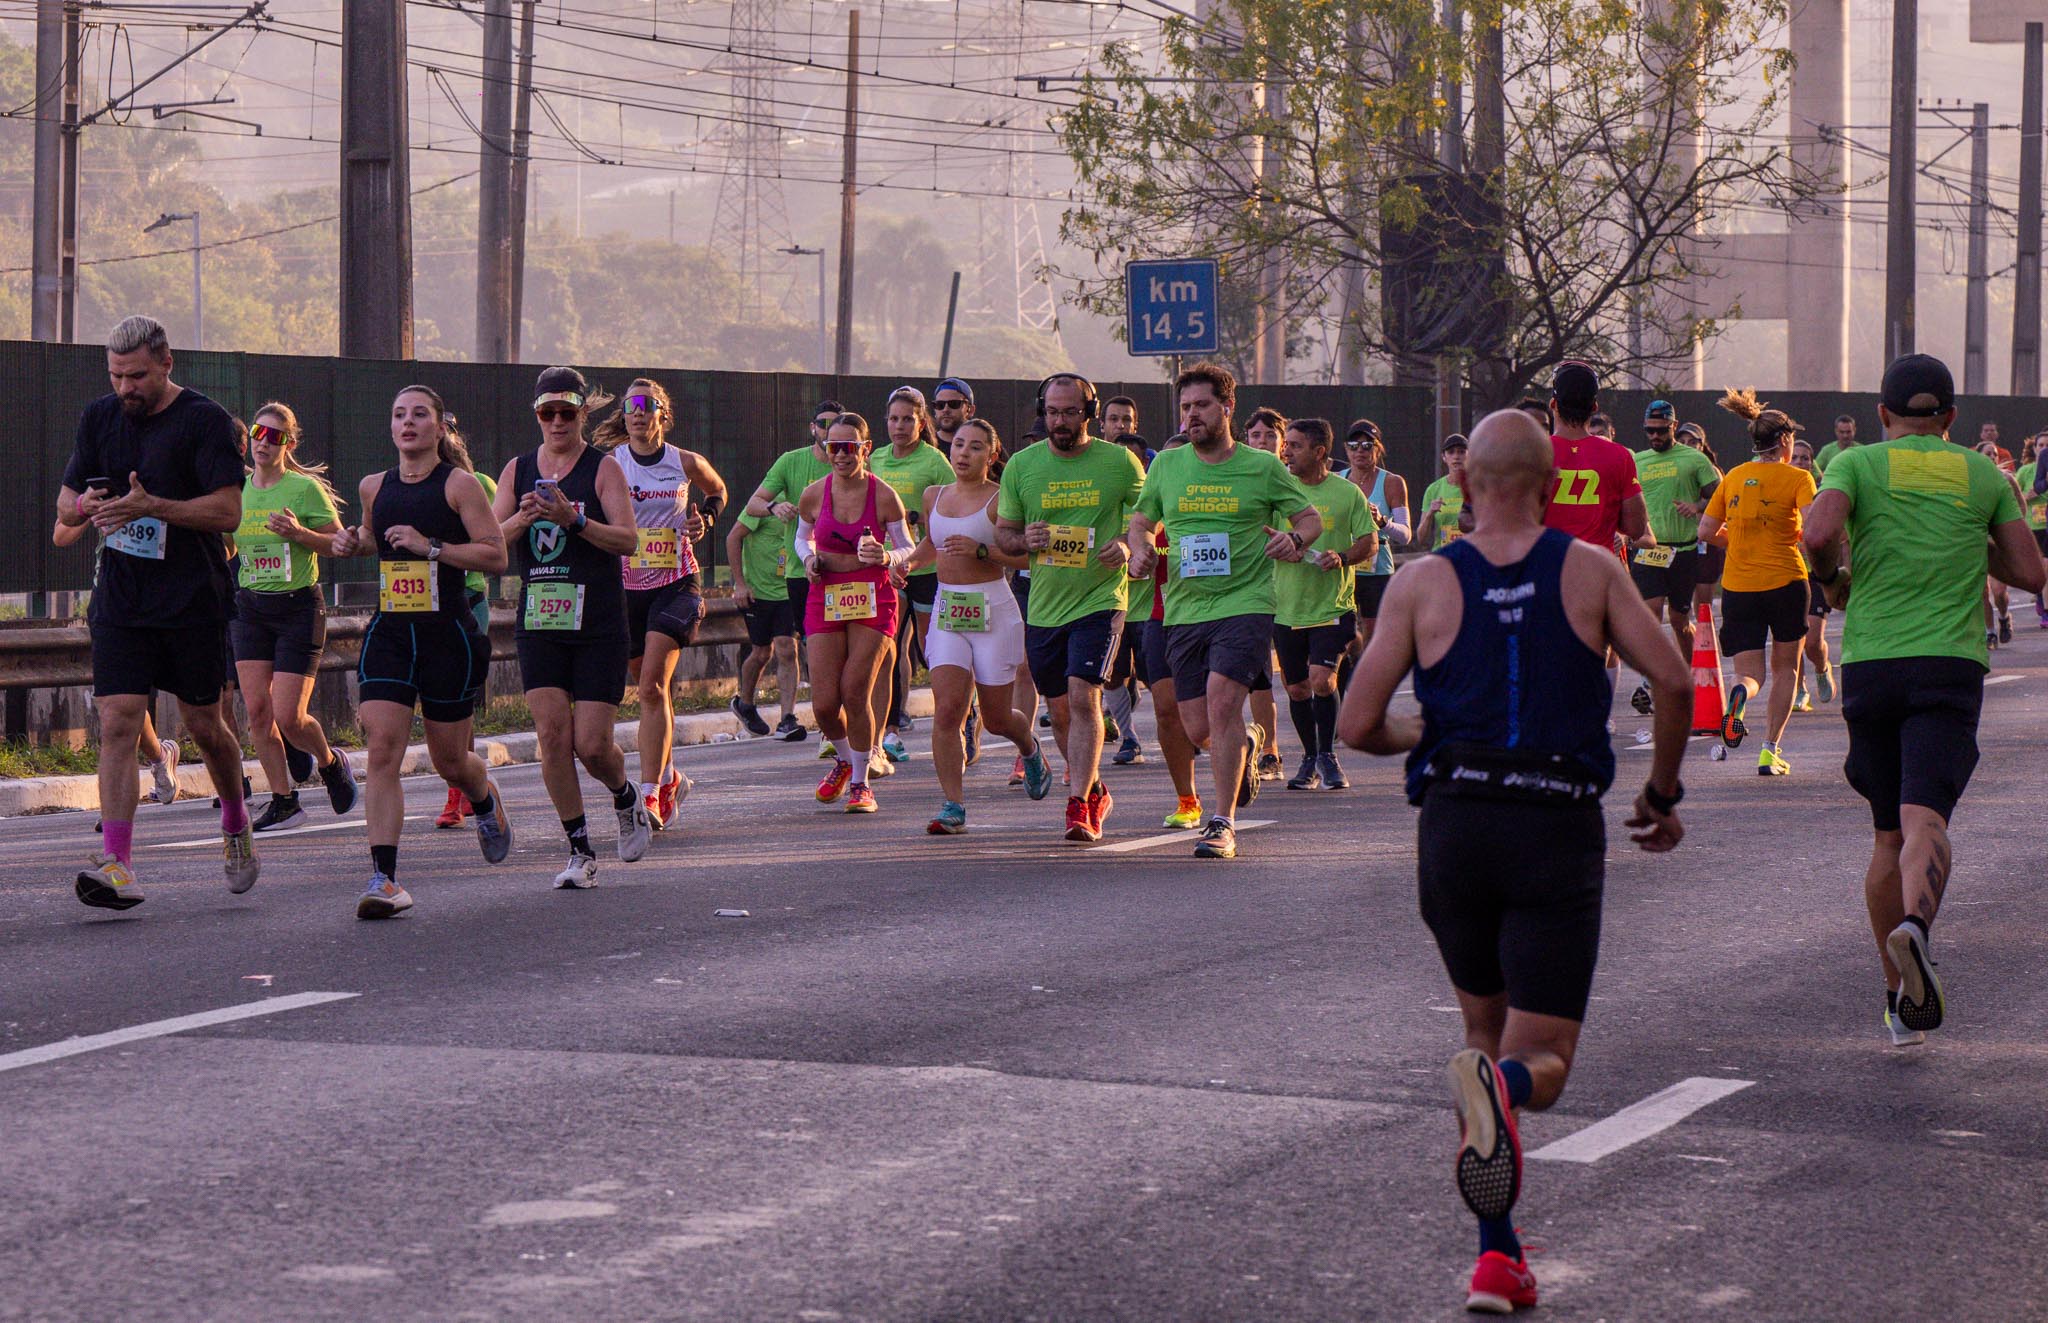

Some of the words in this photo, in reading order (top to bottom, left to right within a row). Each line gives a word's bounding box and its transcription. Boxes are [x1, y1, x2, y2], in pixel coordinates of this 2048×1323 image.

[1149, 276, 1198, 303] km
[1141, 311, 1206, 341] 14,5
[1048, 479, 1093, 492] greenv
[1186, 484, 1233, 496] greenv
[1041, 496, 1100, 509] BRIDGE
[1178, 502, 1240, 513] BRIDGE
[645, 541, 674, 554] 4077
[1053, 540, 1085, 554] 4892
[1192, 548, 1227, 562] 5506
[253, 556, 281, 570] 1910
[529, 566, 570, 576] NAVASTRI
[392, 578, 425, 594] 4313
[540, 599, 571, 614] 2579
[840, 594, 867, 607] 4019
[951, 605, 981, 618] 2765
